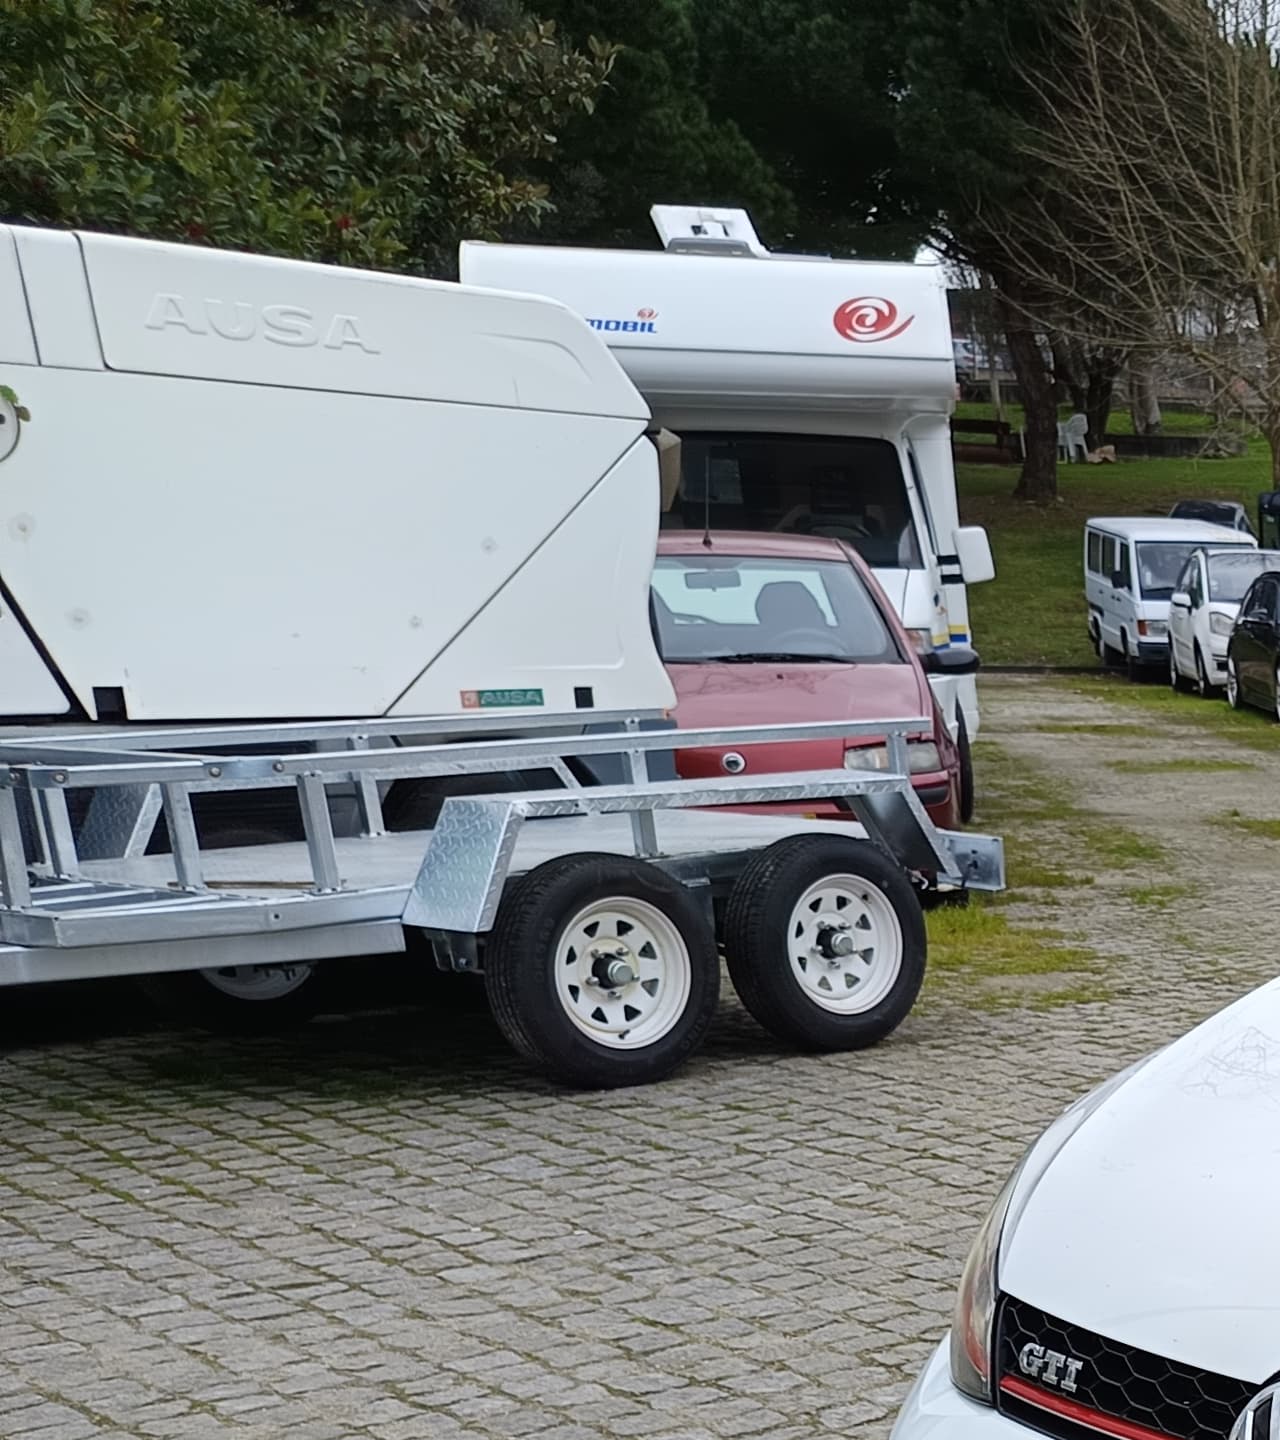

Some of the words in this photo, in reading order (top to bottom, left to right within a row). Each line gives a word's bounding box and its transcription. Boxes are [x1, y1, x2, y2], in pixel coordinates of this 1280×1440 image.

[145, 293, 381, 356] AUSA
[480, 690, 542, 705] AUSA
[1019, 1342, 1084, 1393] GTI
